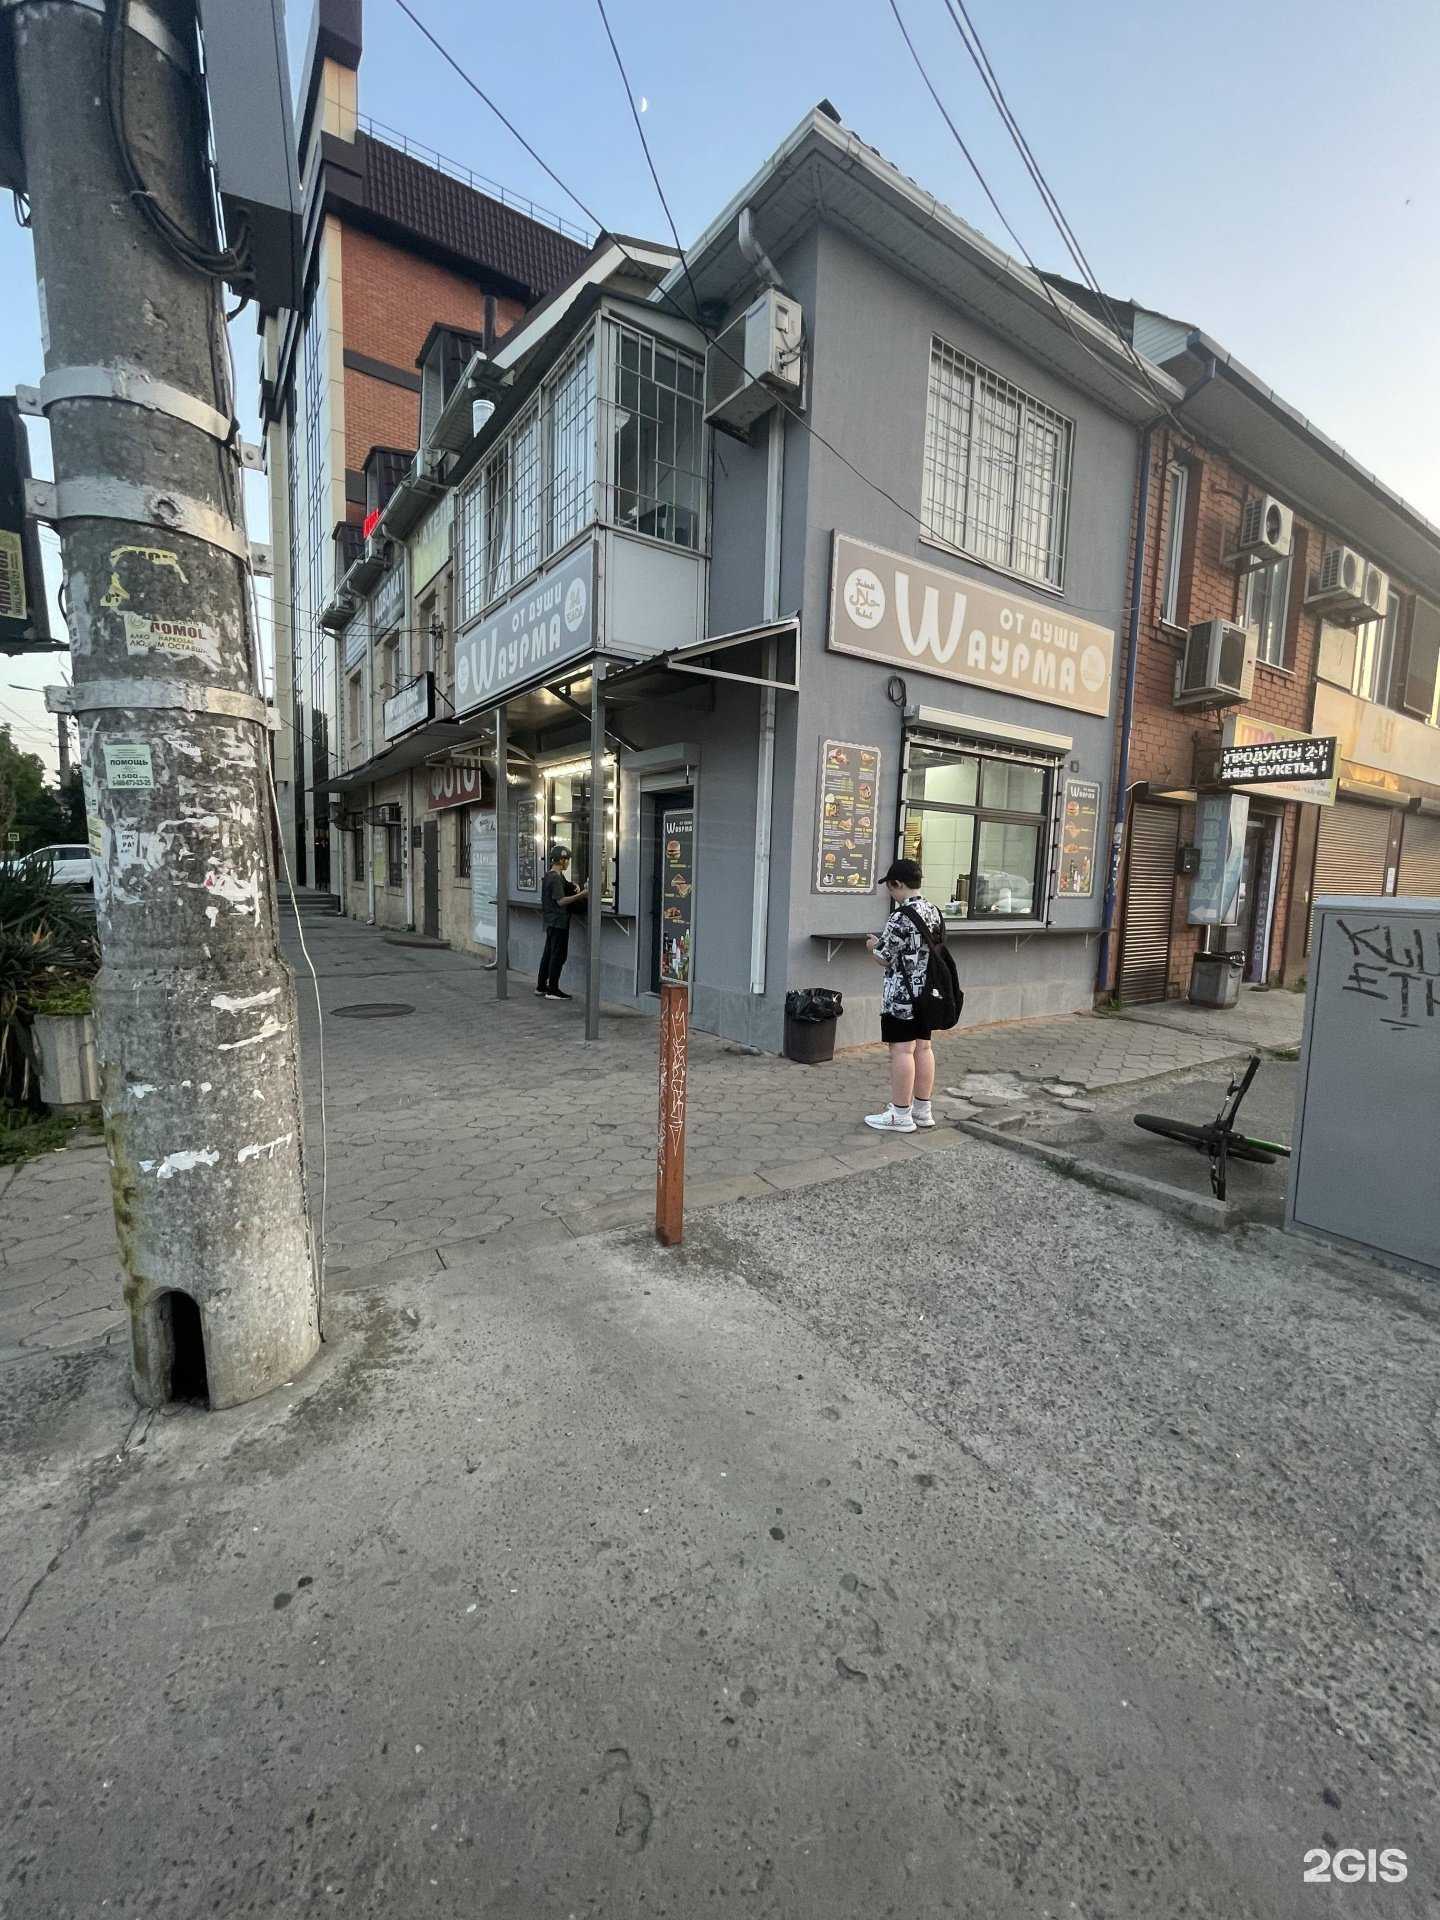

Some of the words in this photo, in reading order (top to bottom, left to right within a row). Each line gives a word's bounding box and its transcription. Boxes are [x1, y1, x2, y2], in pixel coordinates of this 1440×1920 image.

[511, 611, 527, 632] ОТ
[999, 607, 1025, 633] ОТ
[1030, 618, 1079, 653] ДУШИ
